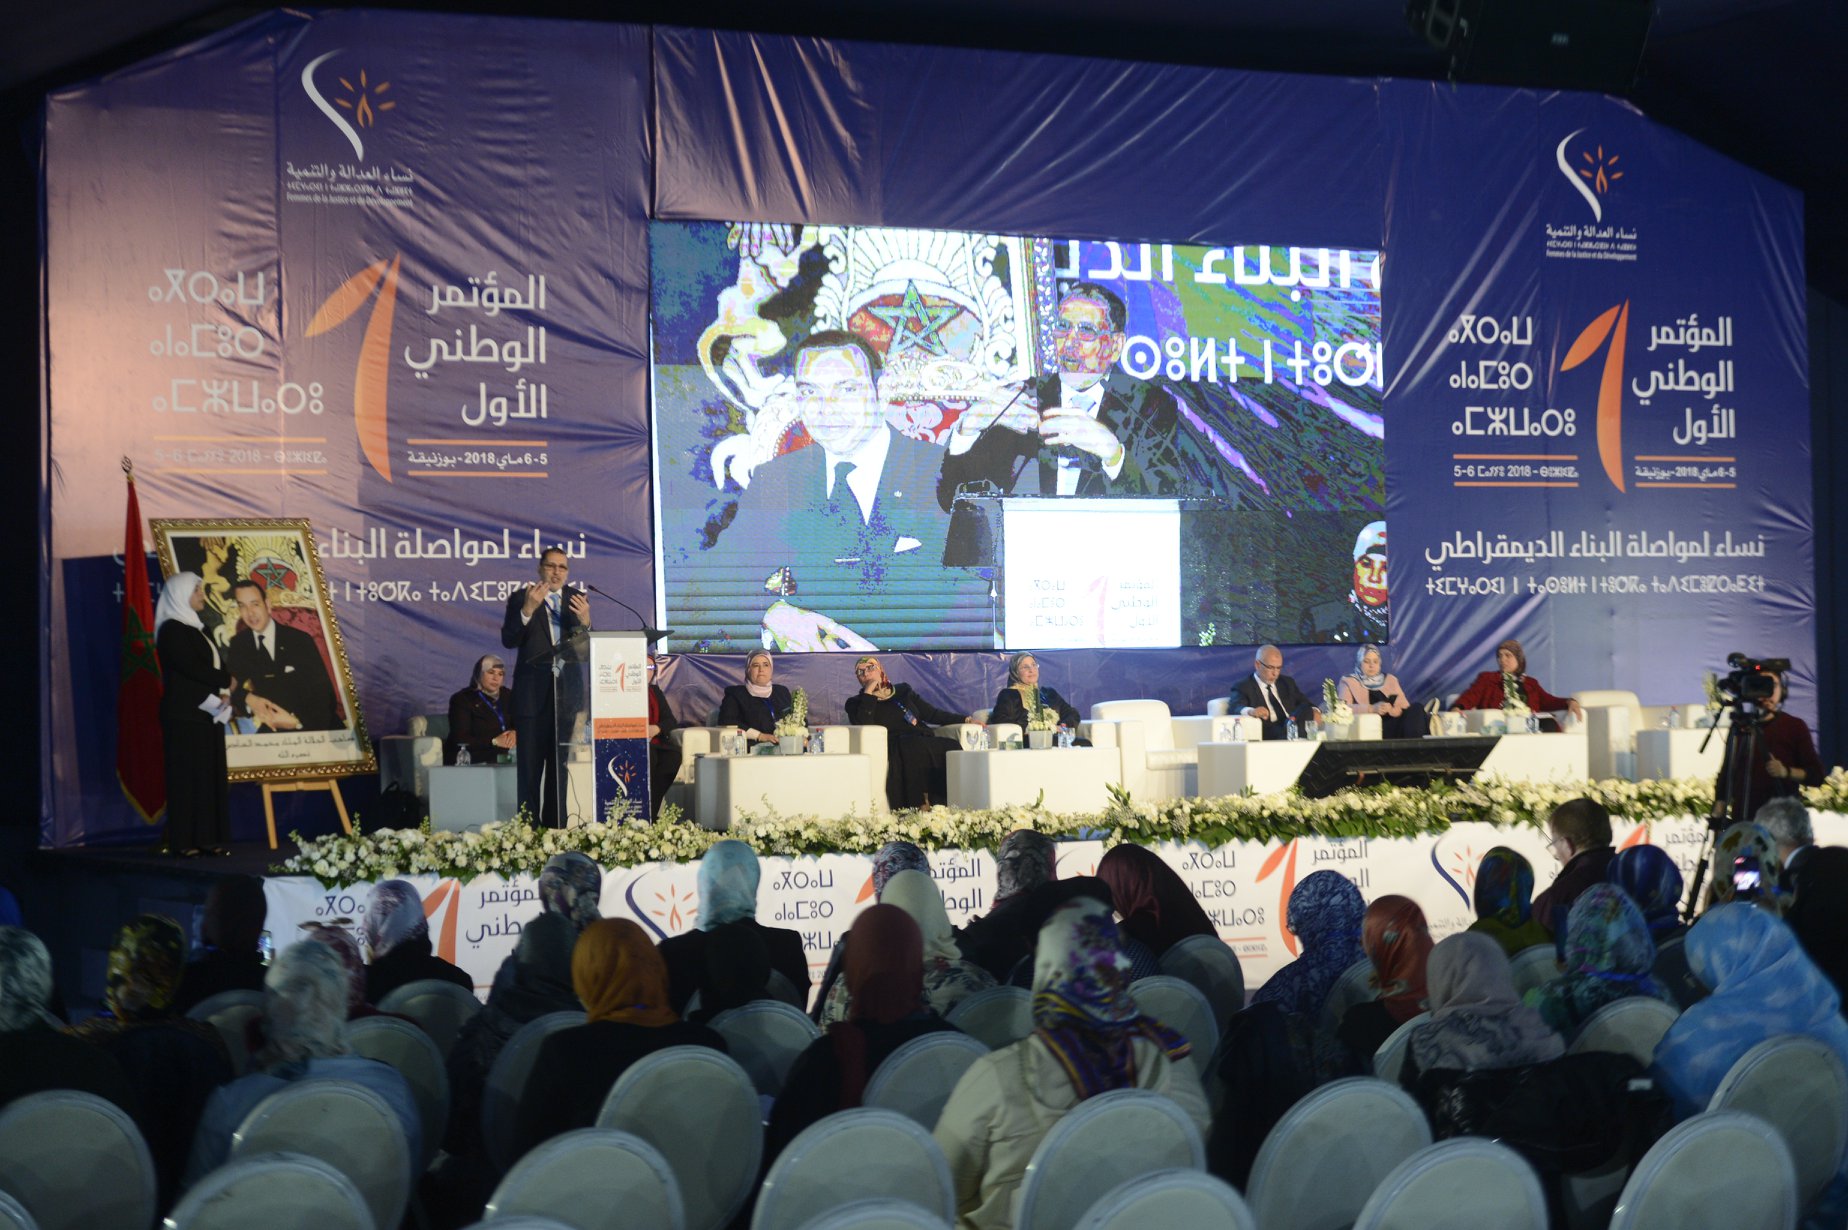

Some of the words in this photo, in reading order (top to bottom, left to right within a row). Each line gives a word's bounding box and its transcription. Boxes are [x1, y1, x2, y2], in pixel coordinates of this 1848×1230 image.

[286, 161, 336, 182] والتنمية
[339, 163, 381, 180] العدالة
[1546, 223, 1582, 241] والتنمية
[1583, 224, 1614, 239] العدالة
[425, 271, 546, 316] المؤتمر
[1647, 314, 1733, 352] المؤتمر
[404, 326, 547, 381] الوطني
[1631, 358, 1735, 406] الوطني
[461, 378, 548, 427] الأول
[1672, 404, 1737, 446] الأول
[318, 527, 386, 566] البناء
[395, 528, 510, 567] لمواصلة
[1424, 530, 1564, 572] الديمقراطي
[1568, 530, 1622, 565] البناء
[1626, 530, 1710, 564] لمواصلة
[1713, 531, 1765, 558] نساء
[1312, 840, 1369, 866] المؤتمر
